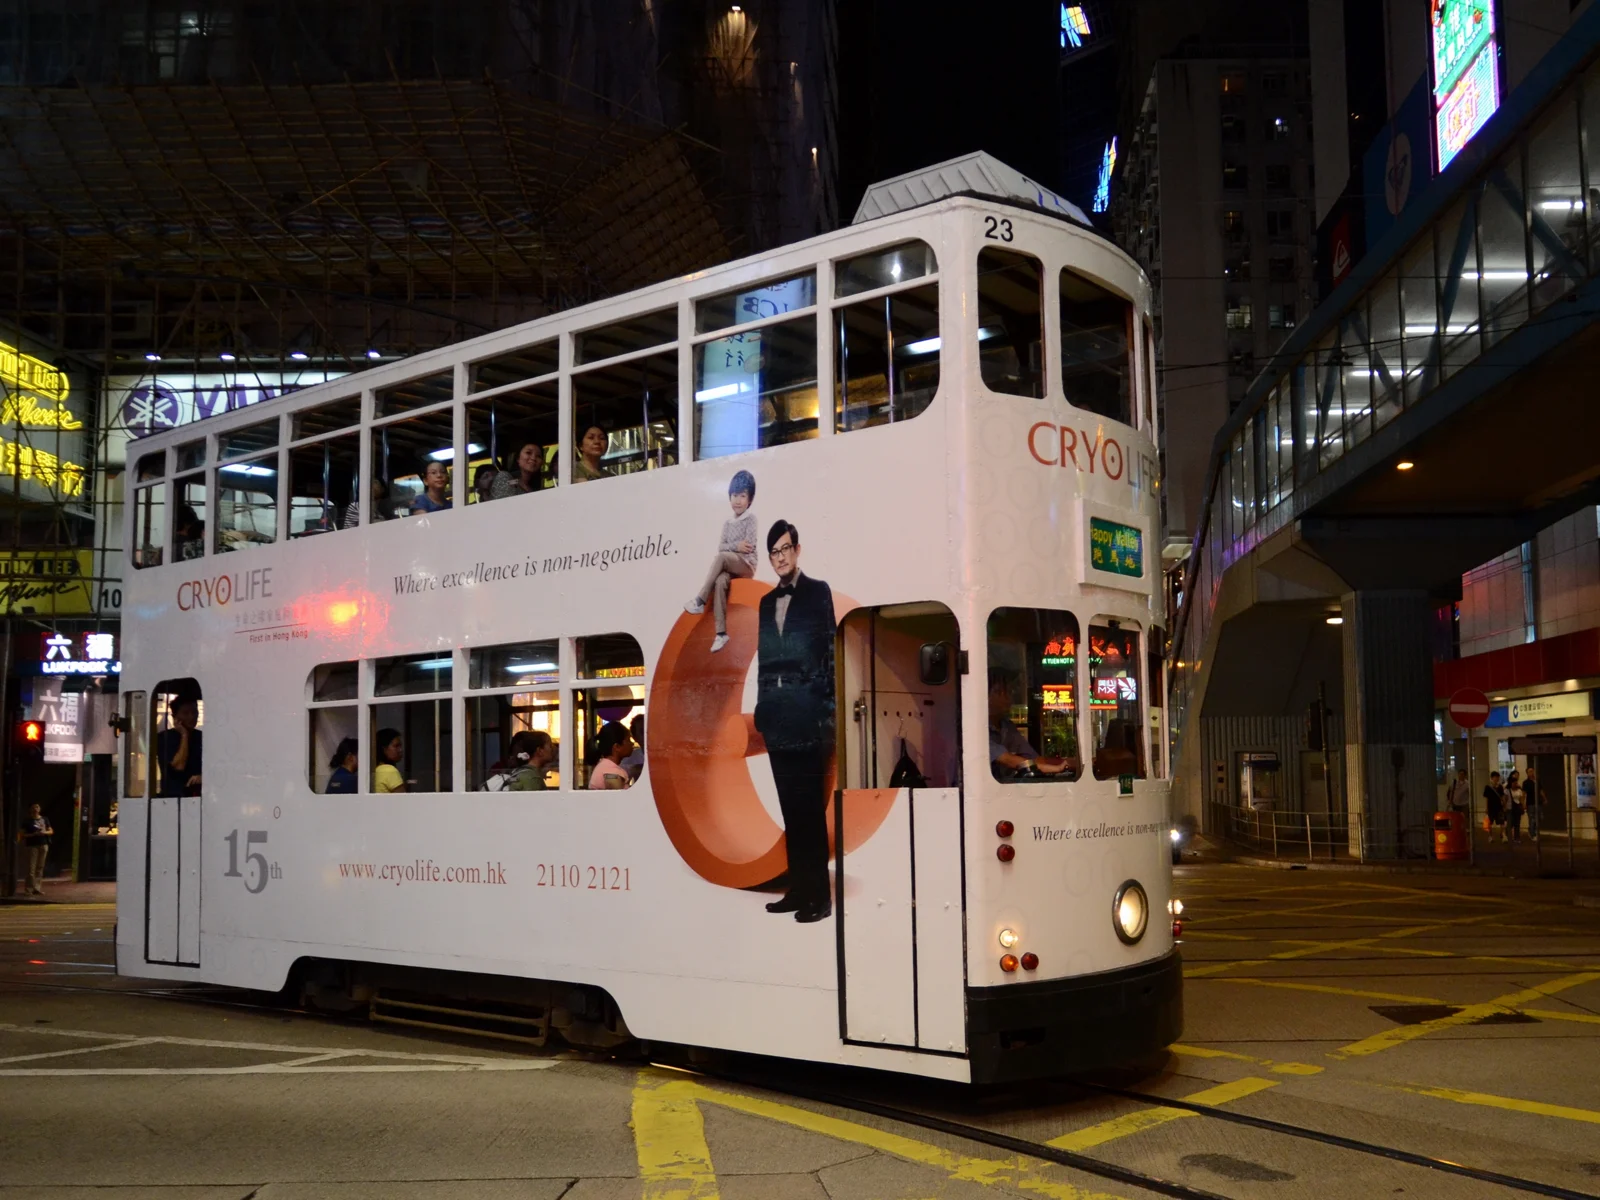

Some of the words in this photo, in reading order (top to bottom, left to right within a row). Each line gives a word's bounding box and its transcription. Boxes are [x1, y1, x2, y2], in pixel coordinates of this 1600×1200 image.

[984, 215, 1014, 242] 23
[0, 437, 85, 497] 利琴行
[1115, 529, 1139, 552] Valley
[43, 560, 72, 575] LEE
[393, 575, 437, 596] Where
[442, 562, 520, 590] excellence
[524, 556, 538, 577] is
[542, 533, 679, 574] non-negotiable.
[177, 567, 273, 612] CRYOLIFE
[46, 633, 114, 660] 六福
[250, 634, 264, 643] First
[265, 633, 271, 642] in
[273, 632, 289, 641] Hong
[292, 630, 308, 639] Kong
[42, 660, 108, 674] LUKFOOK
[1098, 686, 1117, 694] MX
[38, 689, 79, 723] 六福
[1032, 825, 1072, 842] Where
[1075, 822, 1125, 840] excellence
[1127, 821, 1134, 835] is
[339, 859, 508, 887] www.cryolife.com.hk
[536, 862, 581, 889] 2110
[587, 865, 632, 891] 2121
